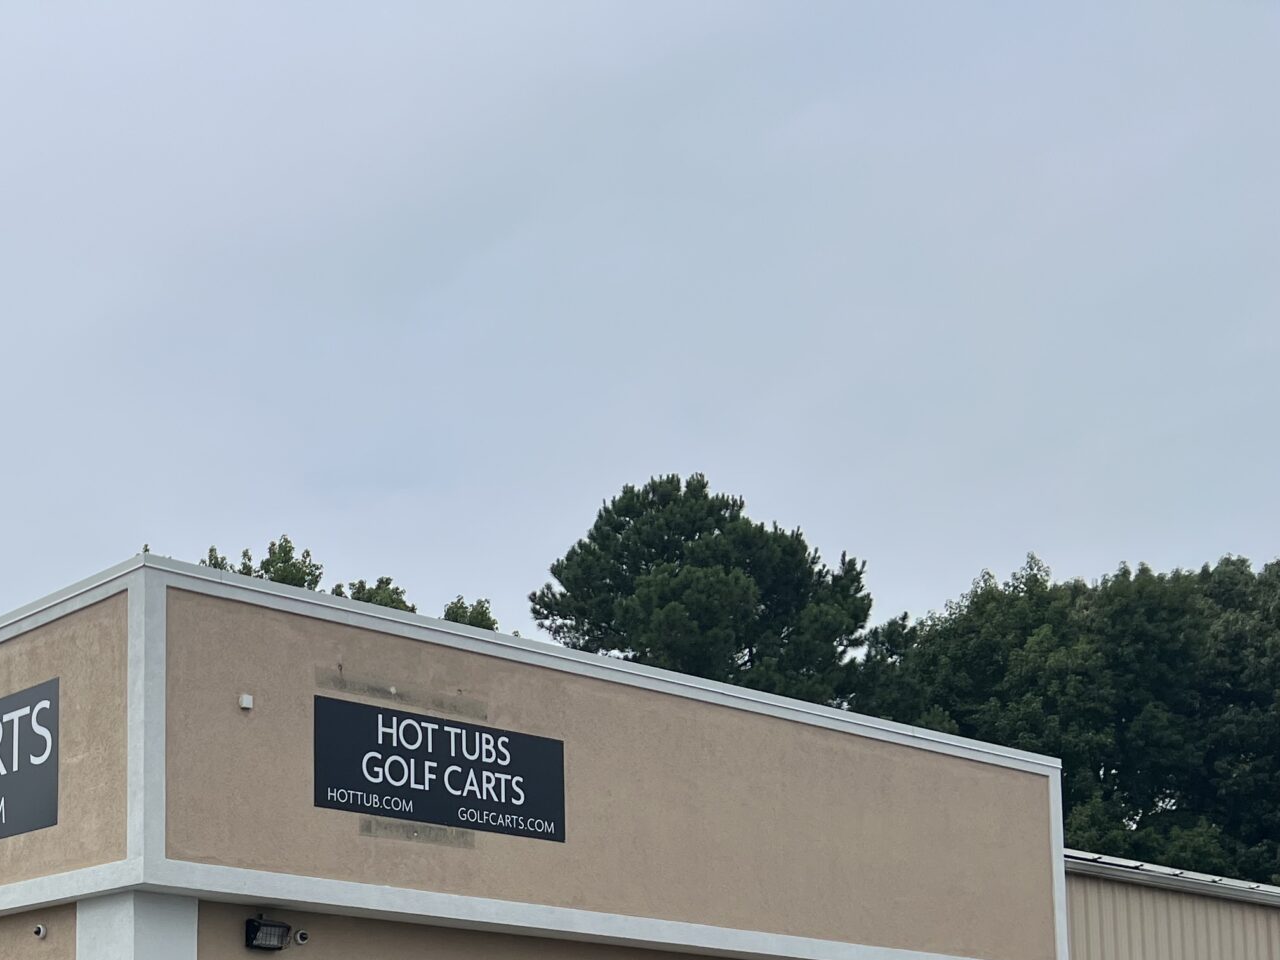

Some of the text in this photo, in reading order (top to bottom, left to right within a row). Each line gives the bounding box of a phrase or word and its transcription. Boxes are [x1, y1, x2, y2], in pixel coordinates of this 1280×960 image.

[377, 713, 511, 766] HOT TUBS
[361, 751, 525, 806] GOLF CARTS
[327, 787, 414, 813] HOTTUB.COM
[457, 807, 555, 834] GOLFCARTS.COM
